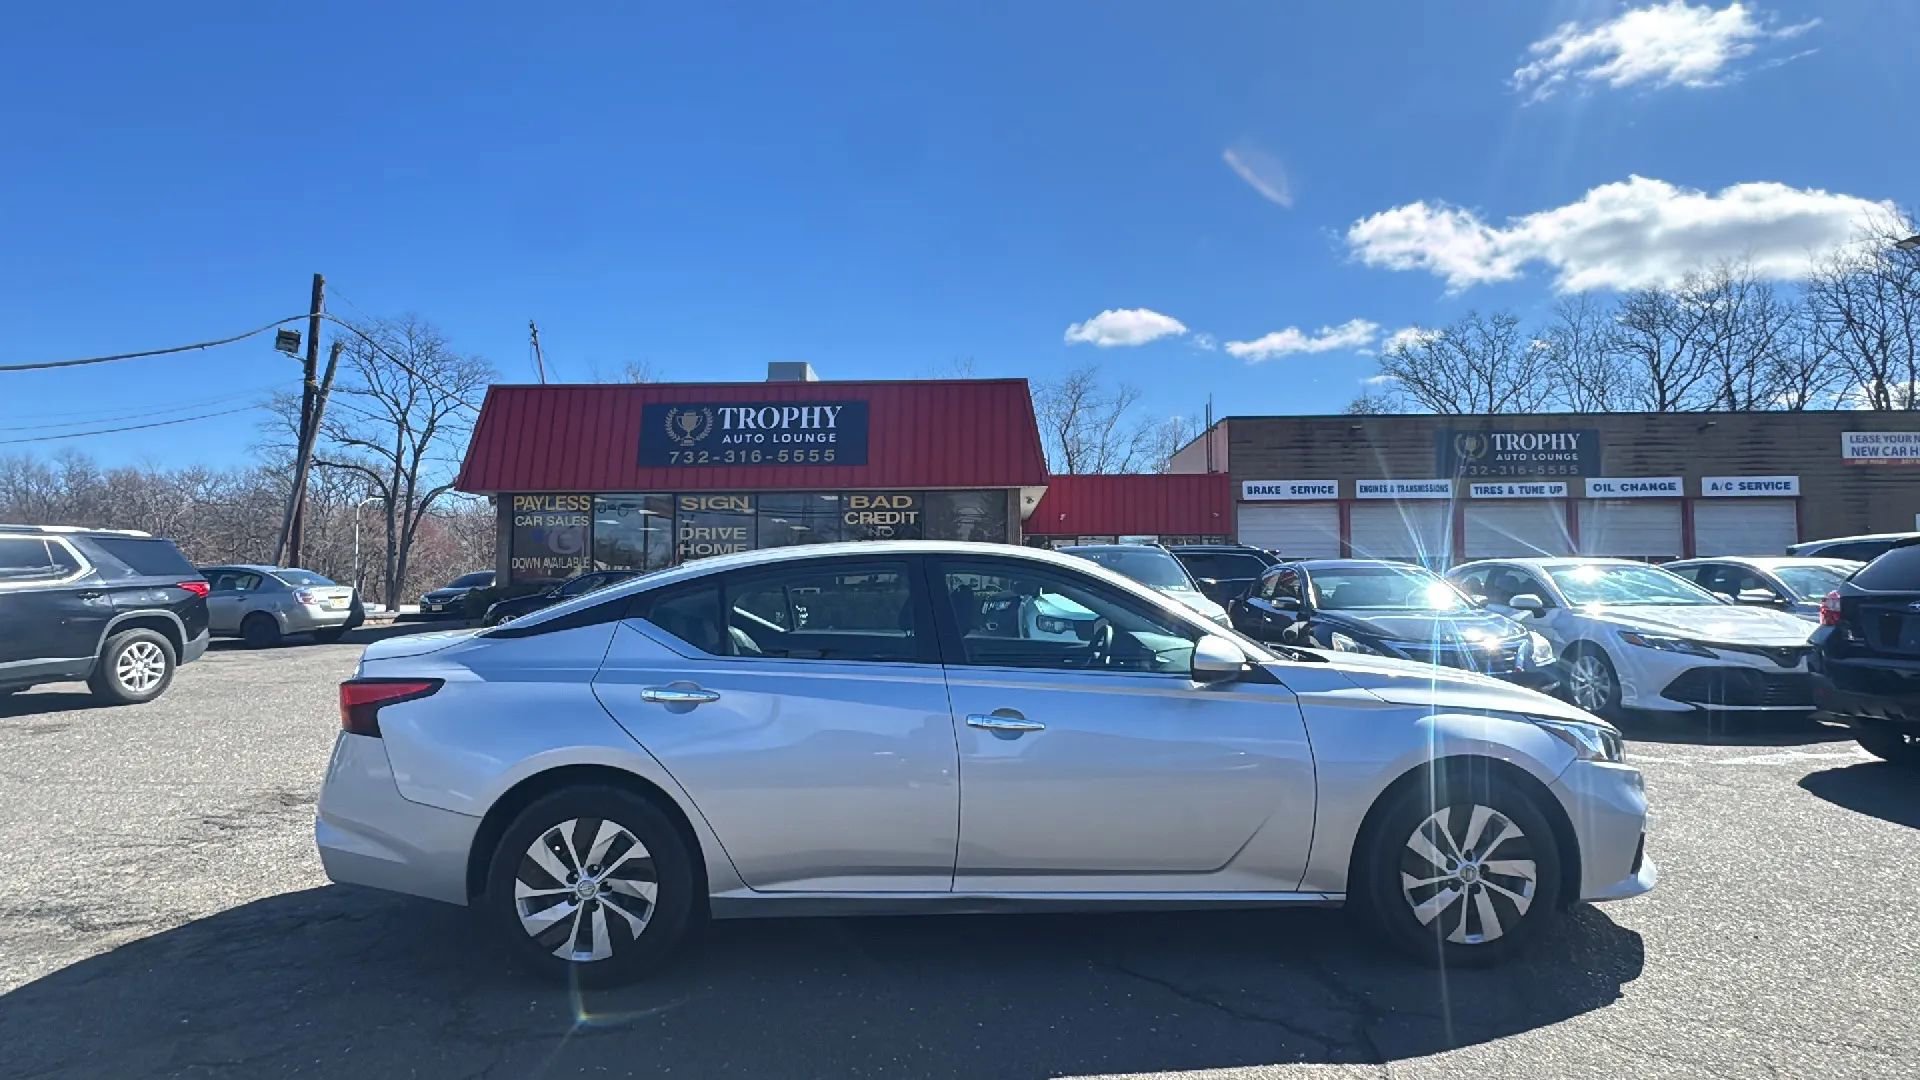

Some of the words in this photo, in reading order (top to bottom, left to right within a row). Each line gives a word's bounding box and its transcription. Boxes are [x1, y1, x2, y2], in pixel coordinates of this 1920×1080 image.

[718, 406, 842, 429] TROPHY
[721, 434, 765, 443] AUTO
[773, 433, 837, 443] LOUNGE
[1491, 433, 1580, 450] TROPHY
[1849, 434, 1880, 443] LEASE
[1883, 434, 1912, 443] YOUR
[669, 449, 835, 464] 732-316-5555
[1496, 453, 1527, 461] AUTO
[1532, 453, 1579, 461] LOUNGE
[1851, 446, 1879, 457] NEW
[1882, 446, 1907, 457] CAR
[1247, 485, 1281, 495] BRAKE
[1291, 485, 1335, 495] SERVICE
[1359, 484, 1388, 493] ENGINES
[1396, 484, 1449, 493] TRANSMISSIONS
[1474, 486, 1503, 495] TIRES
[1508, 486, 1515, 495] &
[1549, 486, 1563, 494] UP
[1593, 483, 1614, 492] OIL
[1620, 482, 1677, 492] CHANGE
[1711, 482, 1733, 491] A/C
[1738, 481, 1791, 491] SERVICE
[513, 495, 591, 511] PAYLESS
[680, 495, 749, 511] SIGN
[850, 495, 913, 509] BAD
[514, 515, 543, 527] CAR
[547, 515, 590, 527] SALES
[844, 511, 919, 525] CREDIT
[680, 527, 747, 540] DRIVE
[680, 543, 747, 555] HOME
[511, 557, 541, 569] DOWN
[542, 556, 591, 569] AVAILABLE
